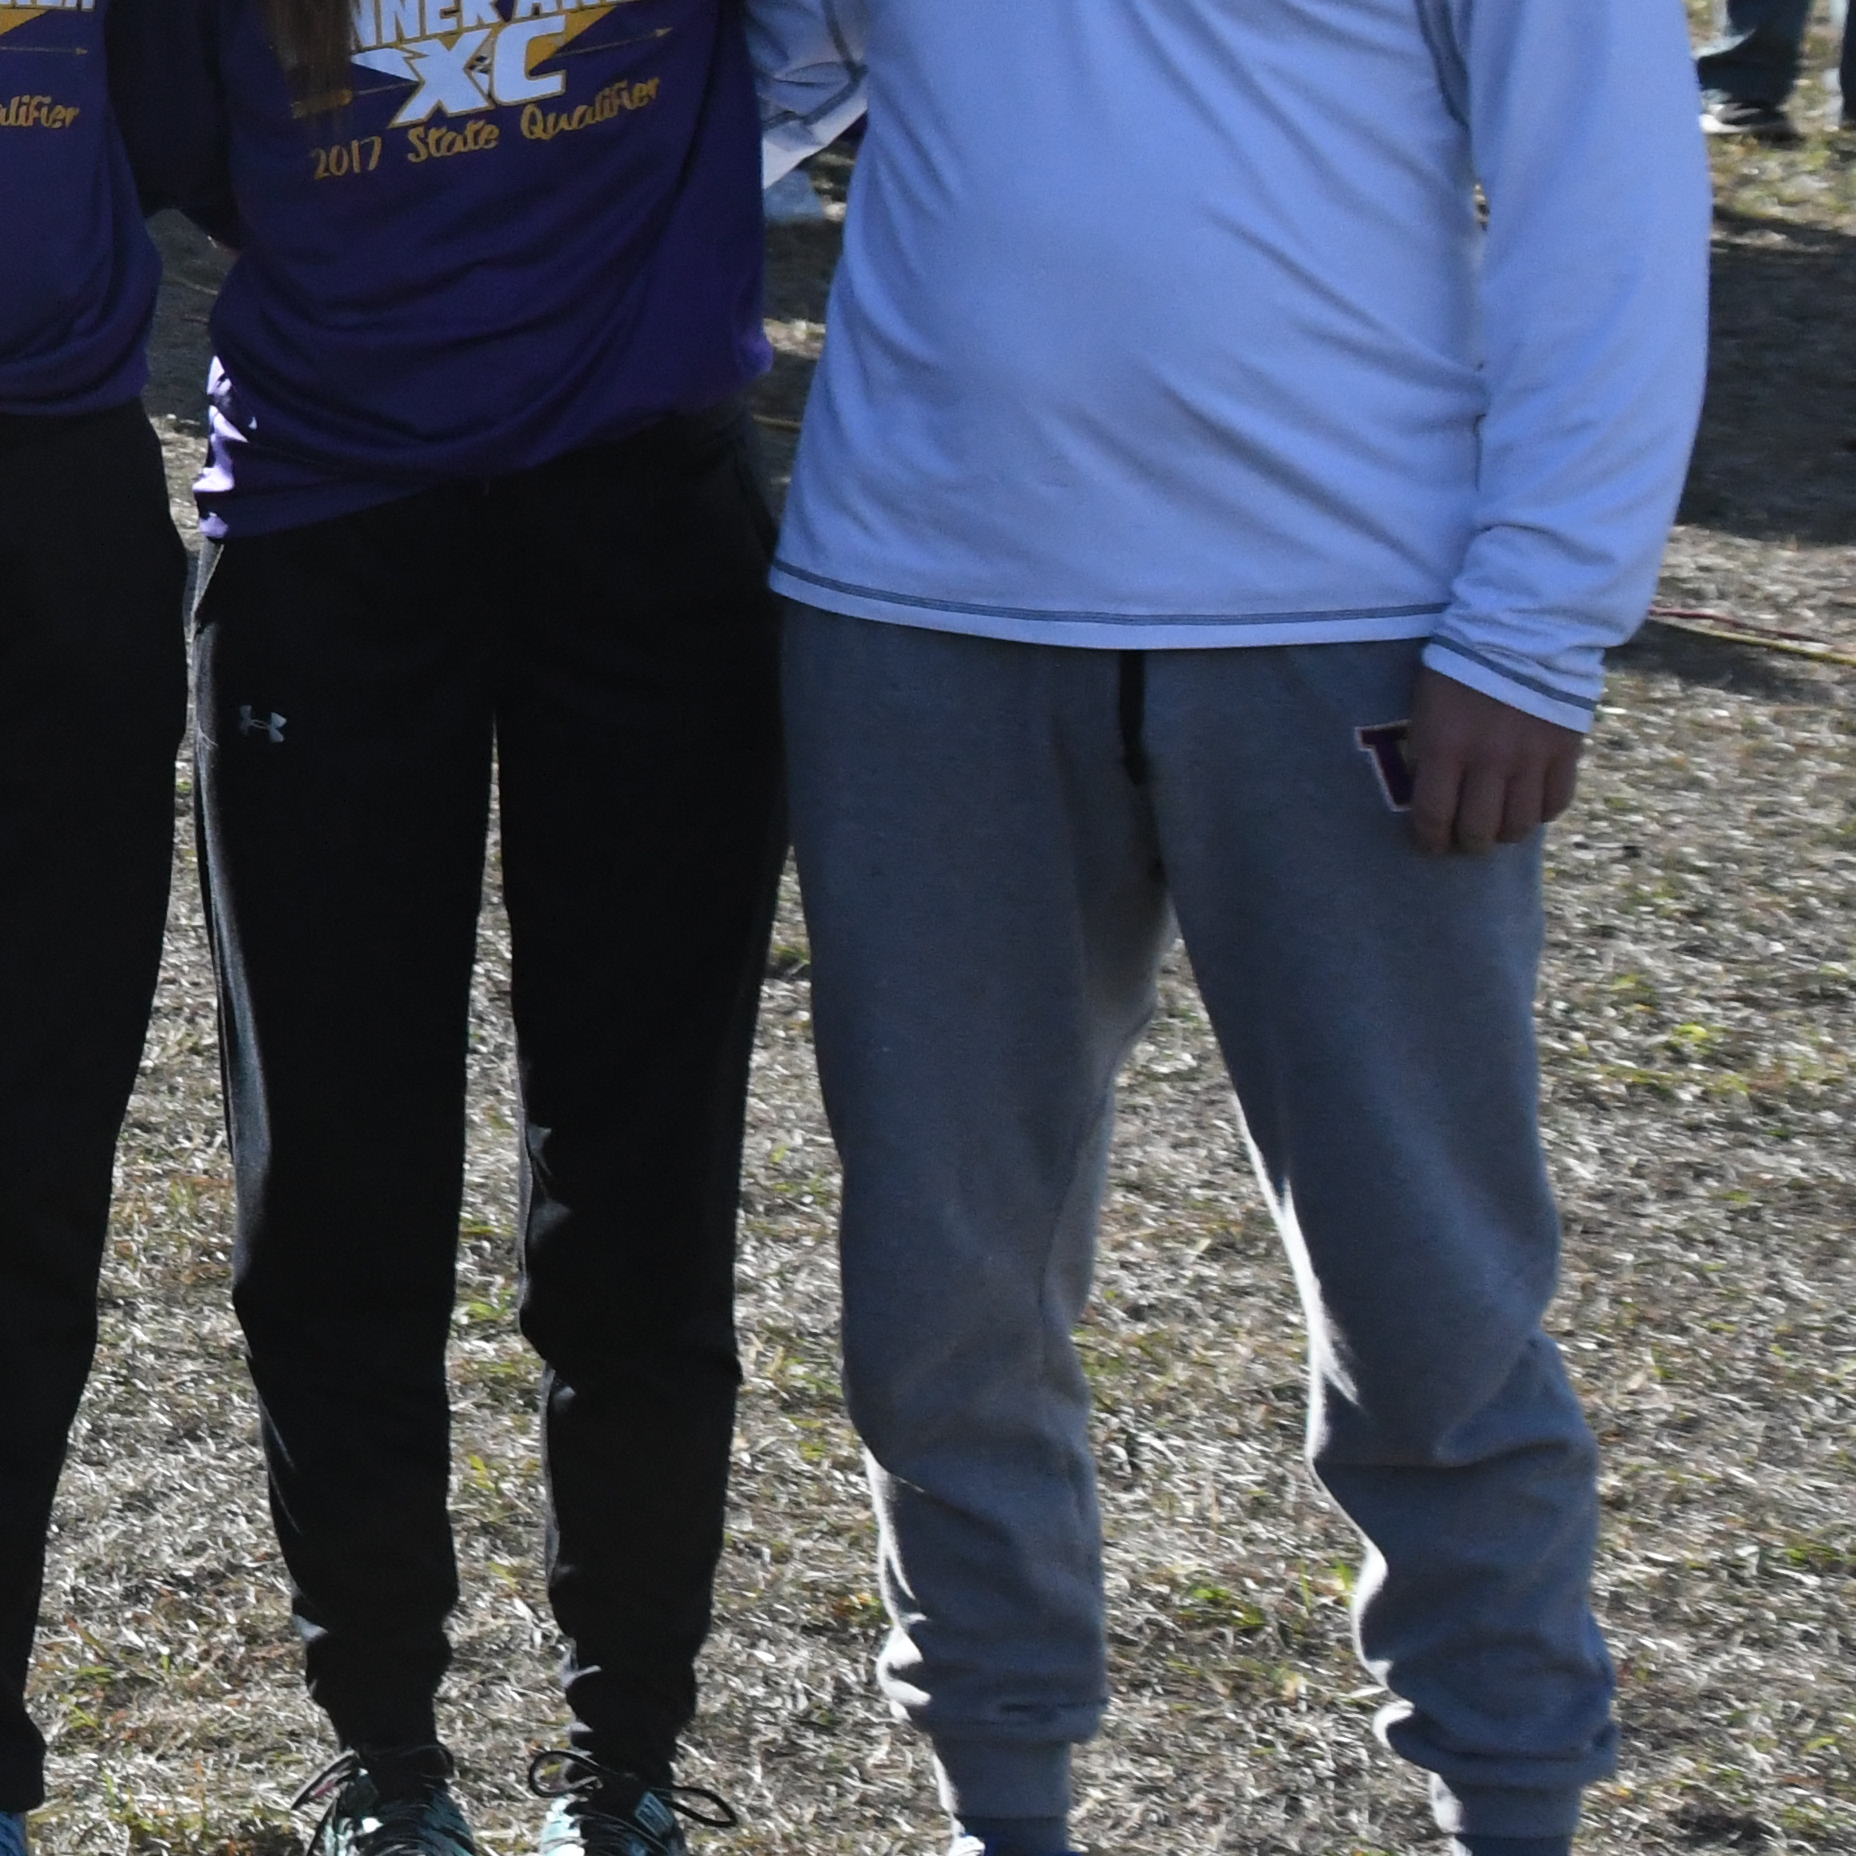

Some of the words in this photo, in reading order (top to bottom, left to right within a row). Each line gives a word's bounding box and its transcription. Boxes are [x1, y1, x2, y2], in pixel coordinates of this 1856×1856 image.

[388, 13, 567, 129] XC
[310, 135, 382, 180] 2017
[407, 119, 500, 164] State
[520, 75, 661, 141] Qualifier
